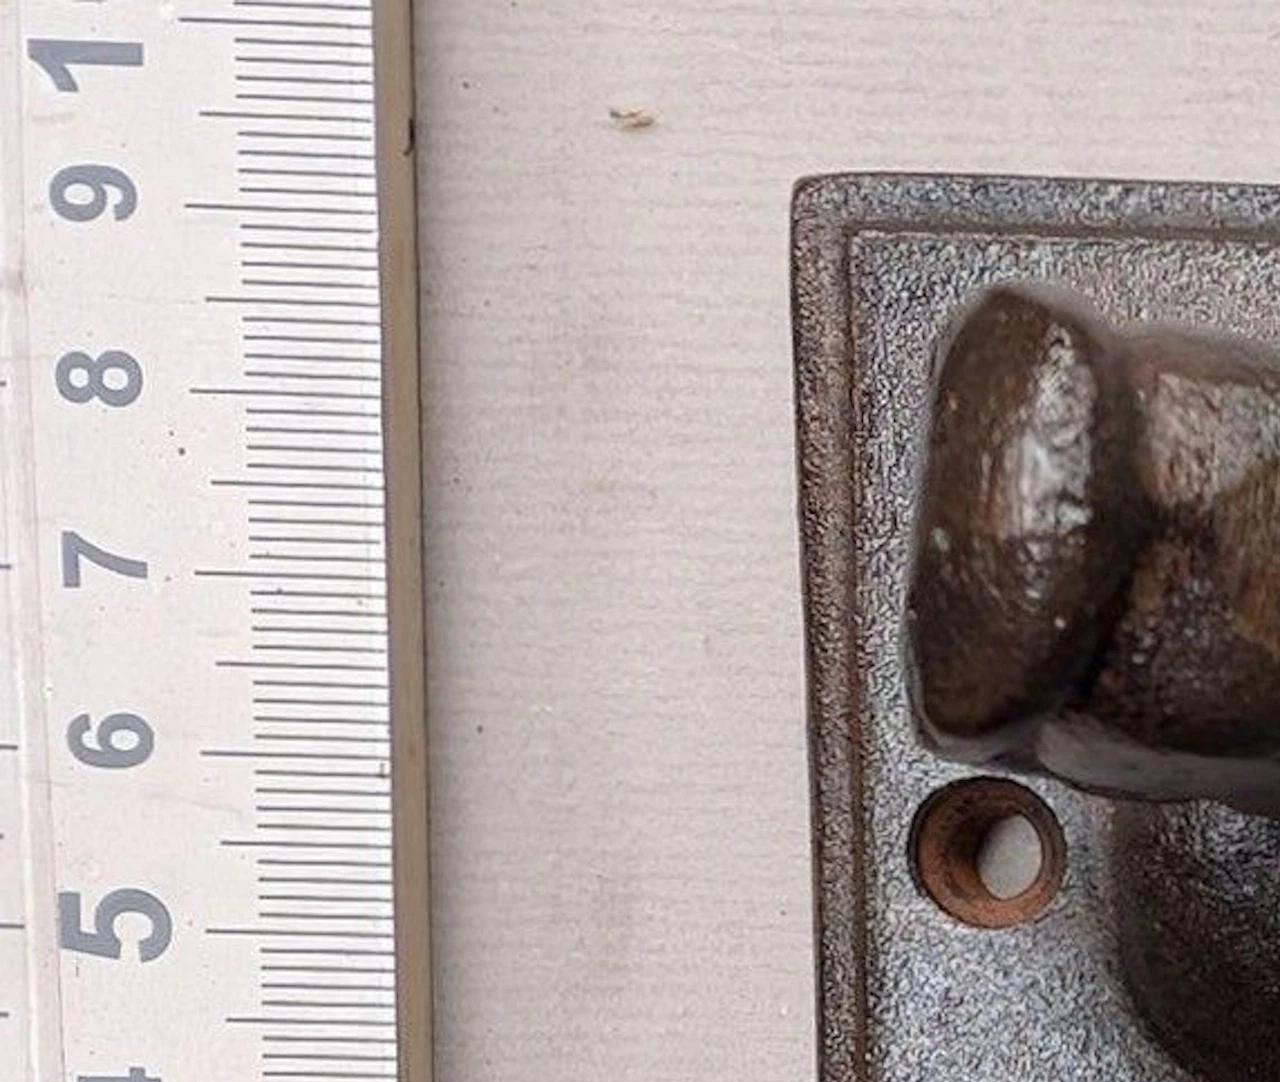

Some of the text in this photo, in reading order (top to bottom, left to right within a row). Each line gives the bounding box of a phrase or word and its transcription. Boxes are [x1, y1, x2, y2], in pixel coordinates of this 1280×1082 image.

[28, 0, 143, 92] 1
[49, 165, 137, 222] 9
[55, 351, 143, 407] 8
[62, 531, 148, 588] 7
[67, 713, 154, 769] 6
[58, 888, 172, 963] 5
